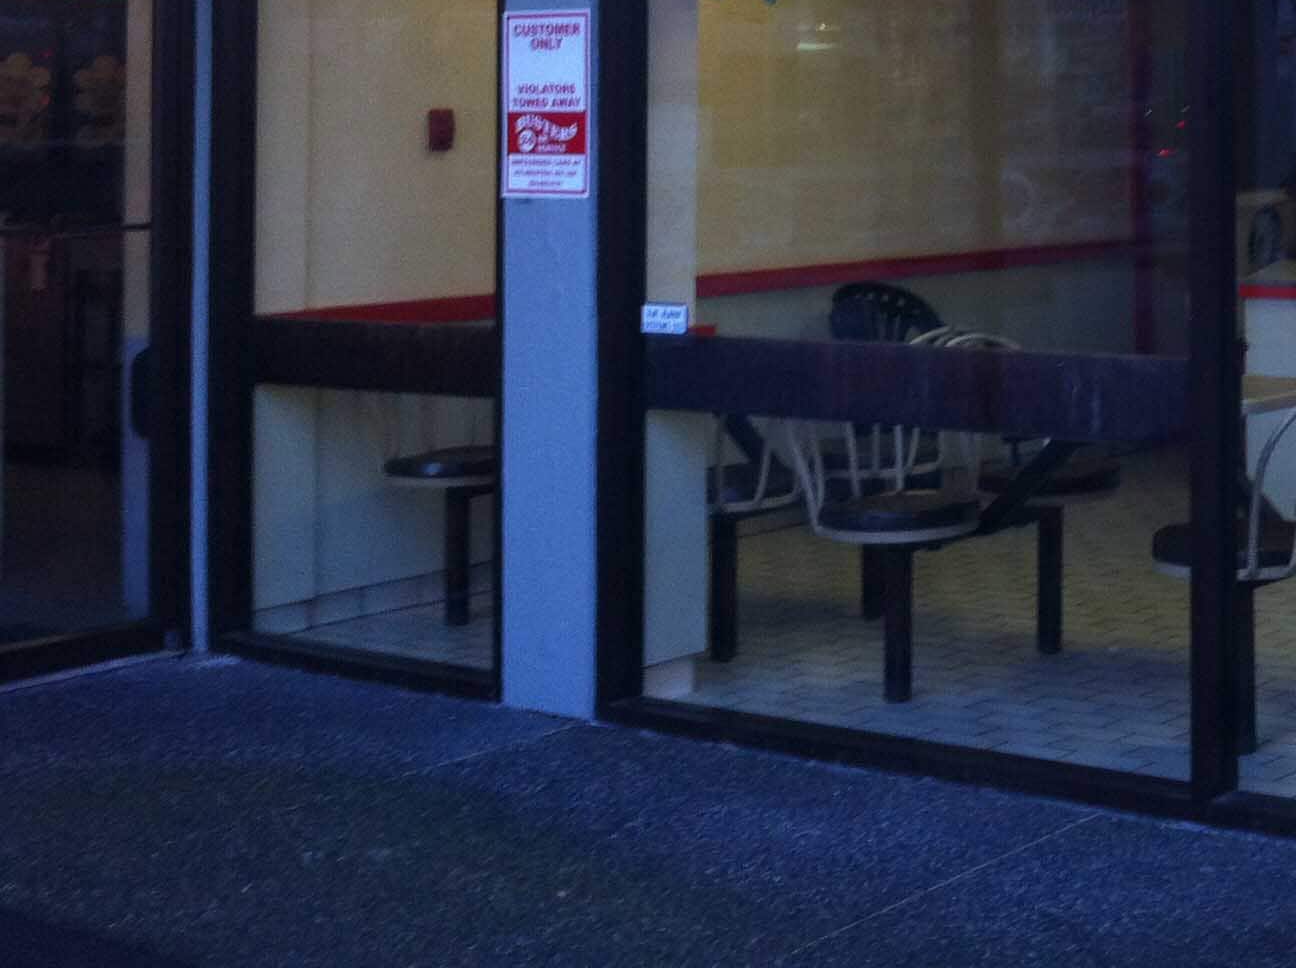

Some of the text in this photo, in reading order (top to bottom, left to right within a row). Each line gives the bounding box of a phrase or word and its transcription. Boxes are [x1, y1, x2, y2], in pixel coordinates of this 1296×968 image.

[513, 22, 581, 38] CUSTOMER
[530, 38, 563, 52] ONLY
[518, 83, 576, 95] VIOLATORS
[513, 96, 581, 108] TOWED AWAY
